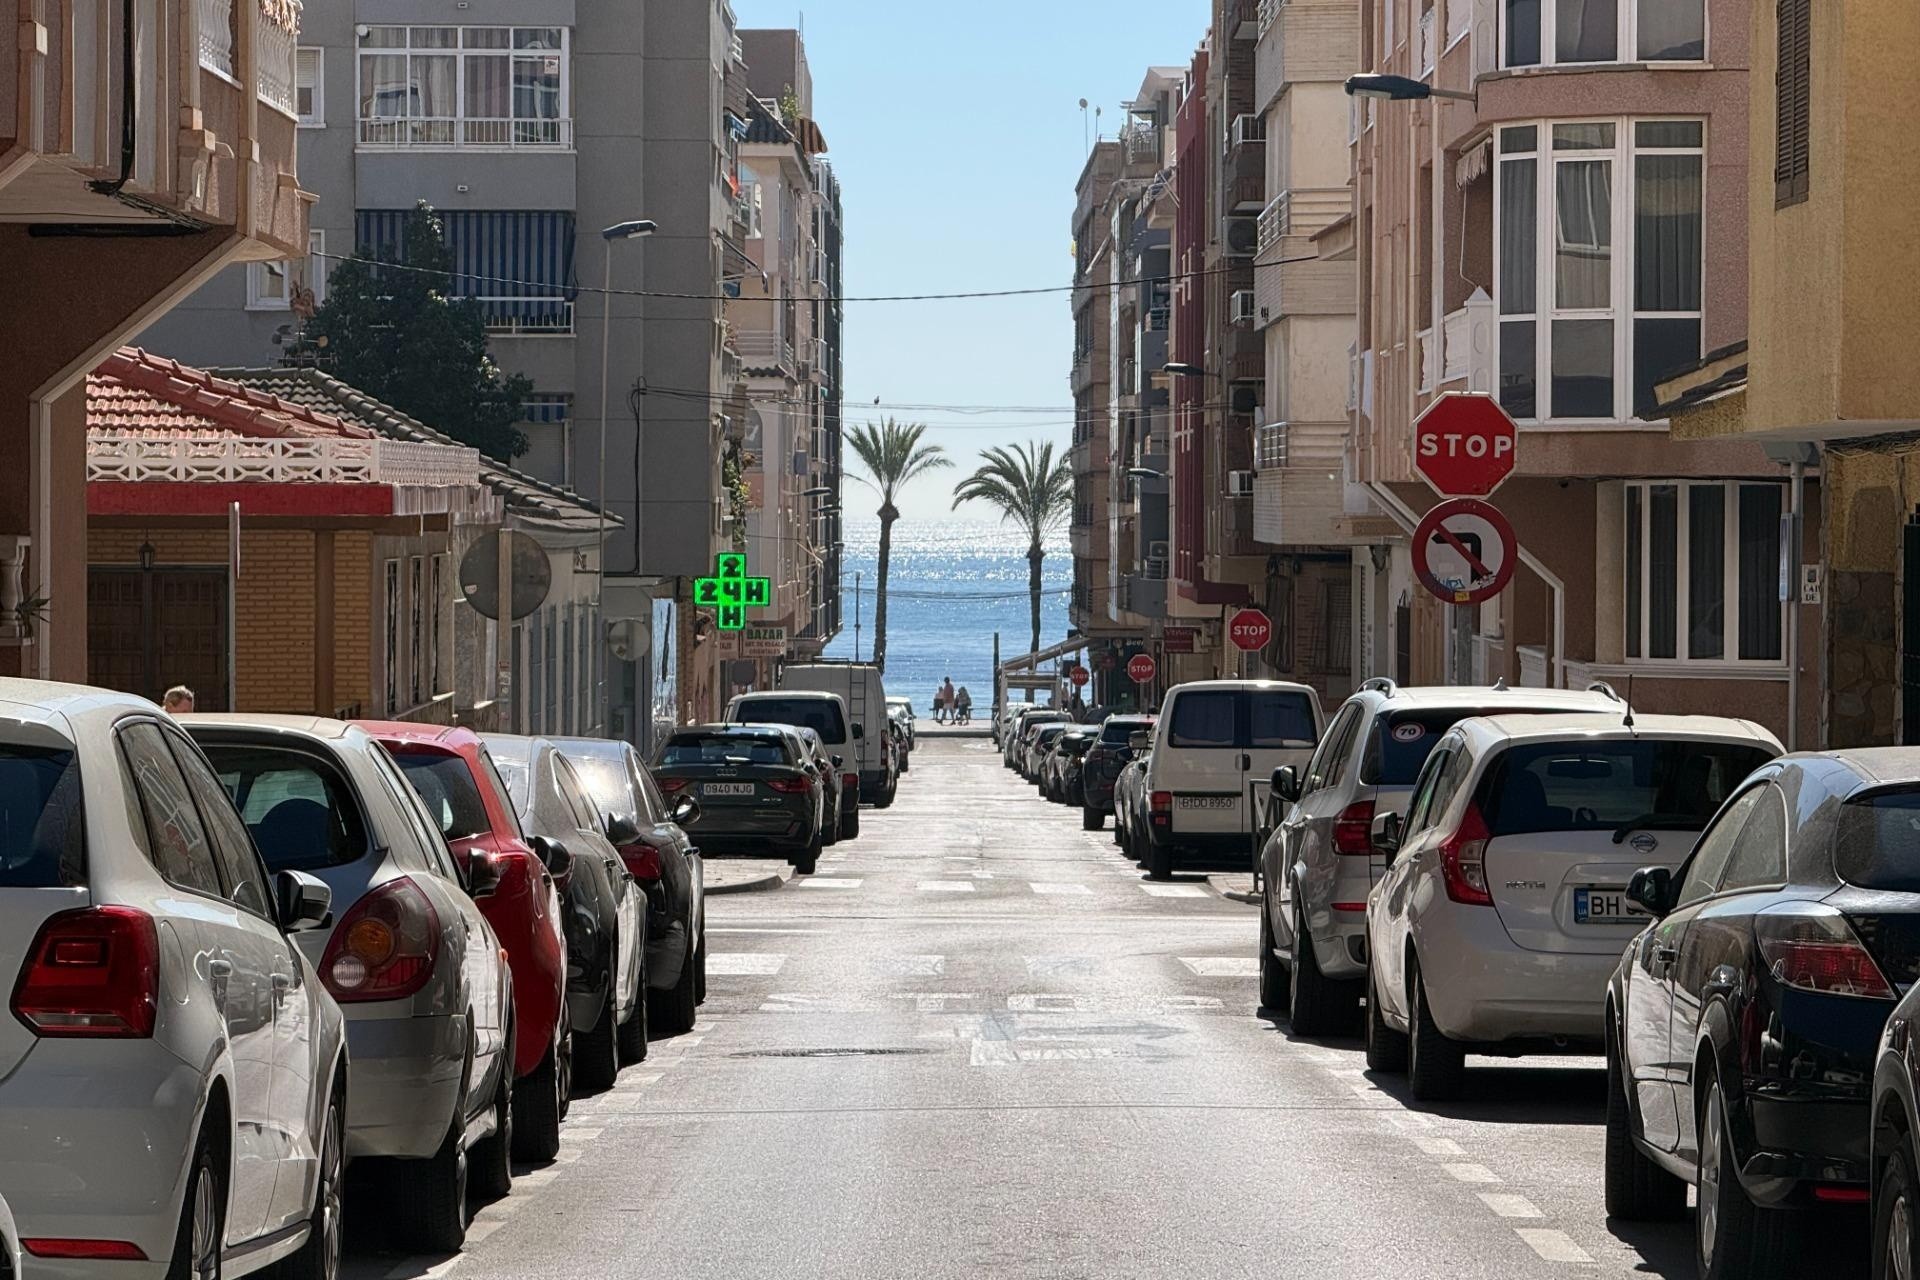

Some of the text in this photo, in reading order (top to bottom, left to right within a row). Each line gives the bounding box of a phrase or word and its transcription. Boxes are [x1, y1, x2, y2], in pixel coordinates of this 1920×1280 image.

[1420, 433, 1512, 458] STOP
[746, 629, 783, 640] BAZAR
[1233, 625, 1267, 636] STOP
[1131, 665, 1153, 673] STOP
[705, 784, 730, 794] 0940
[1182, 798, 1189, 808] B
[1209, 798, 1232, 808] 8950
[1591, 896, 1619, 915] BH
